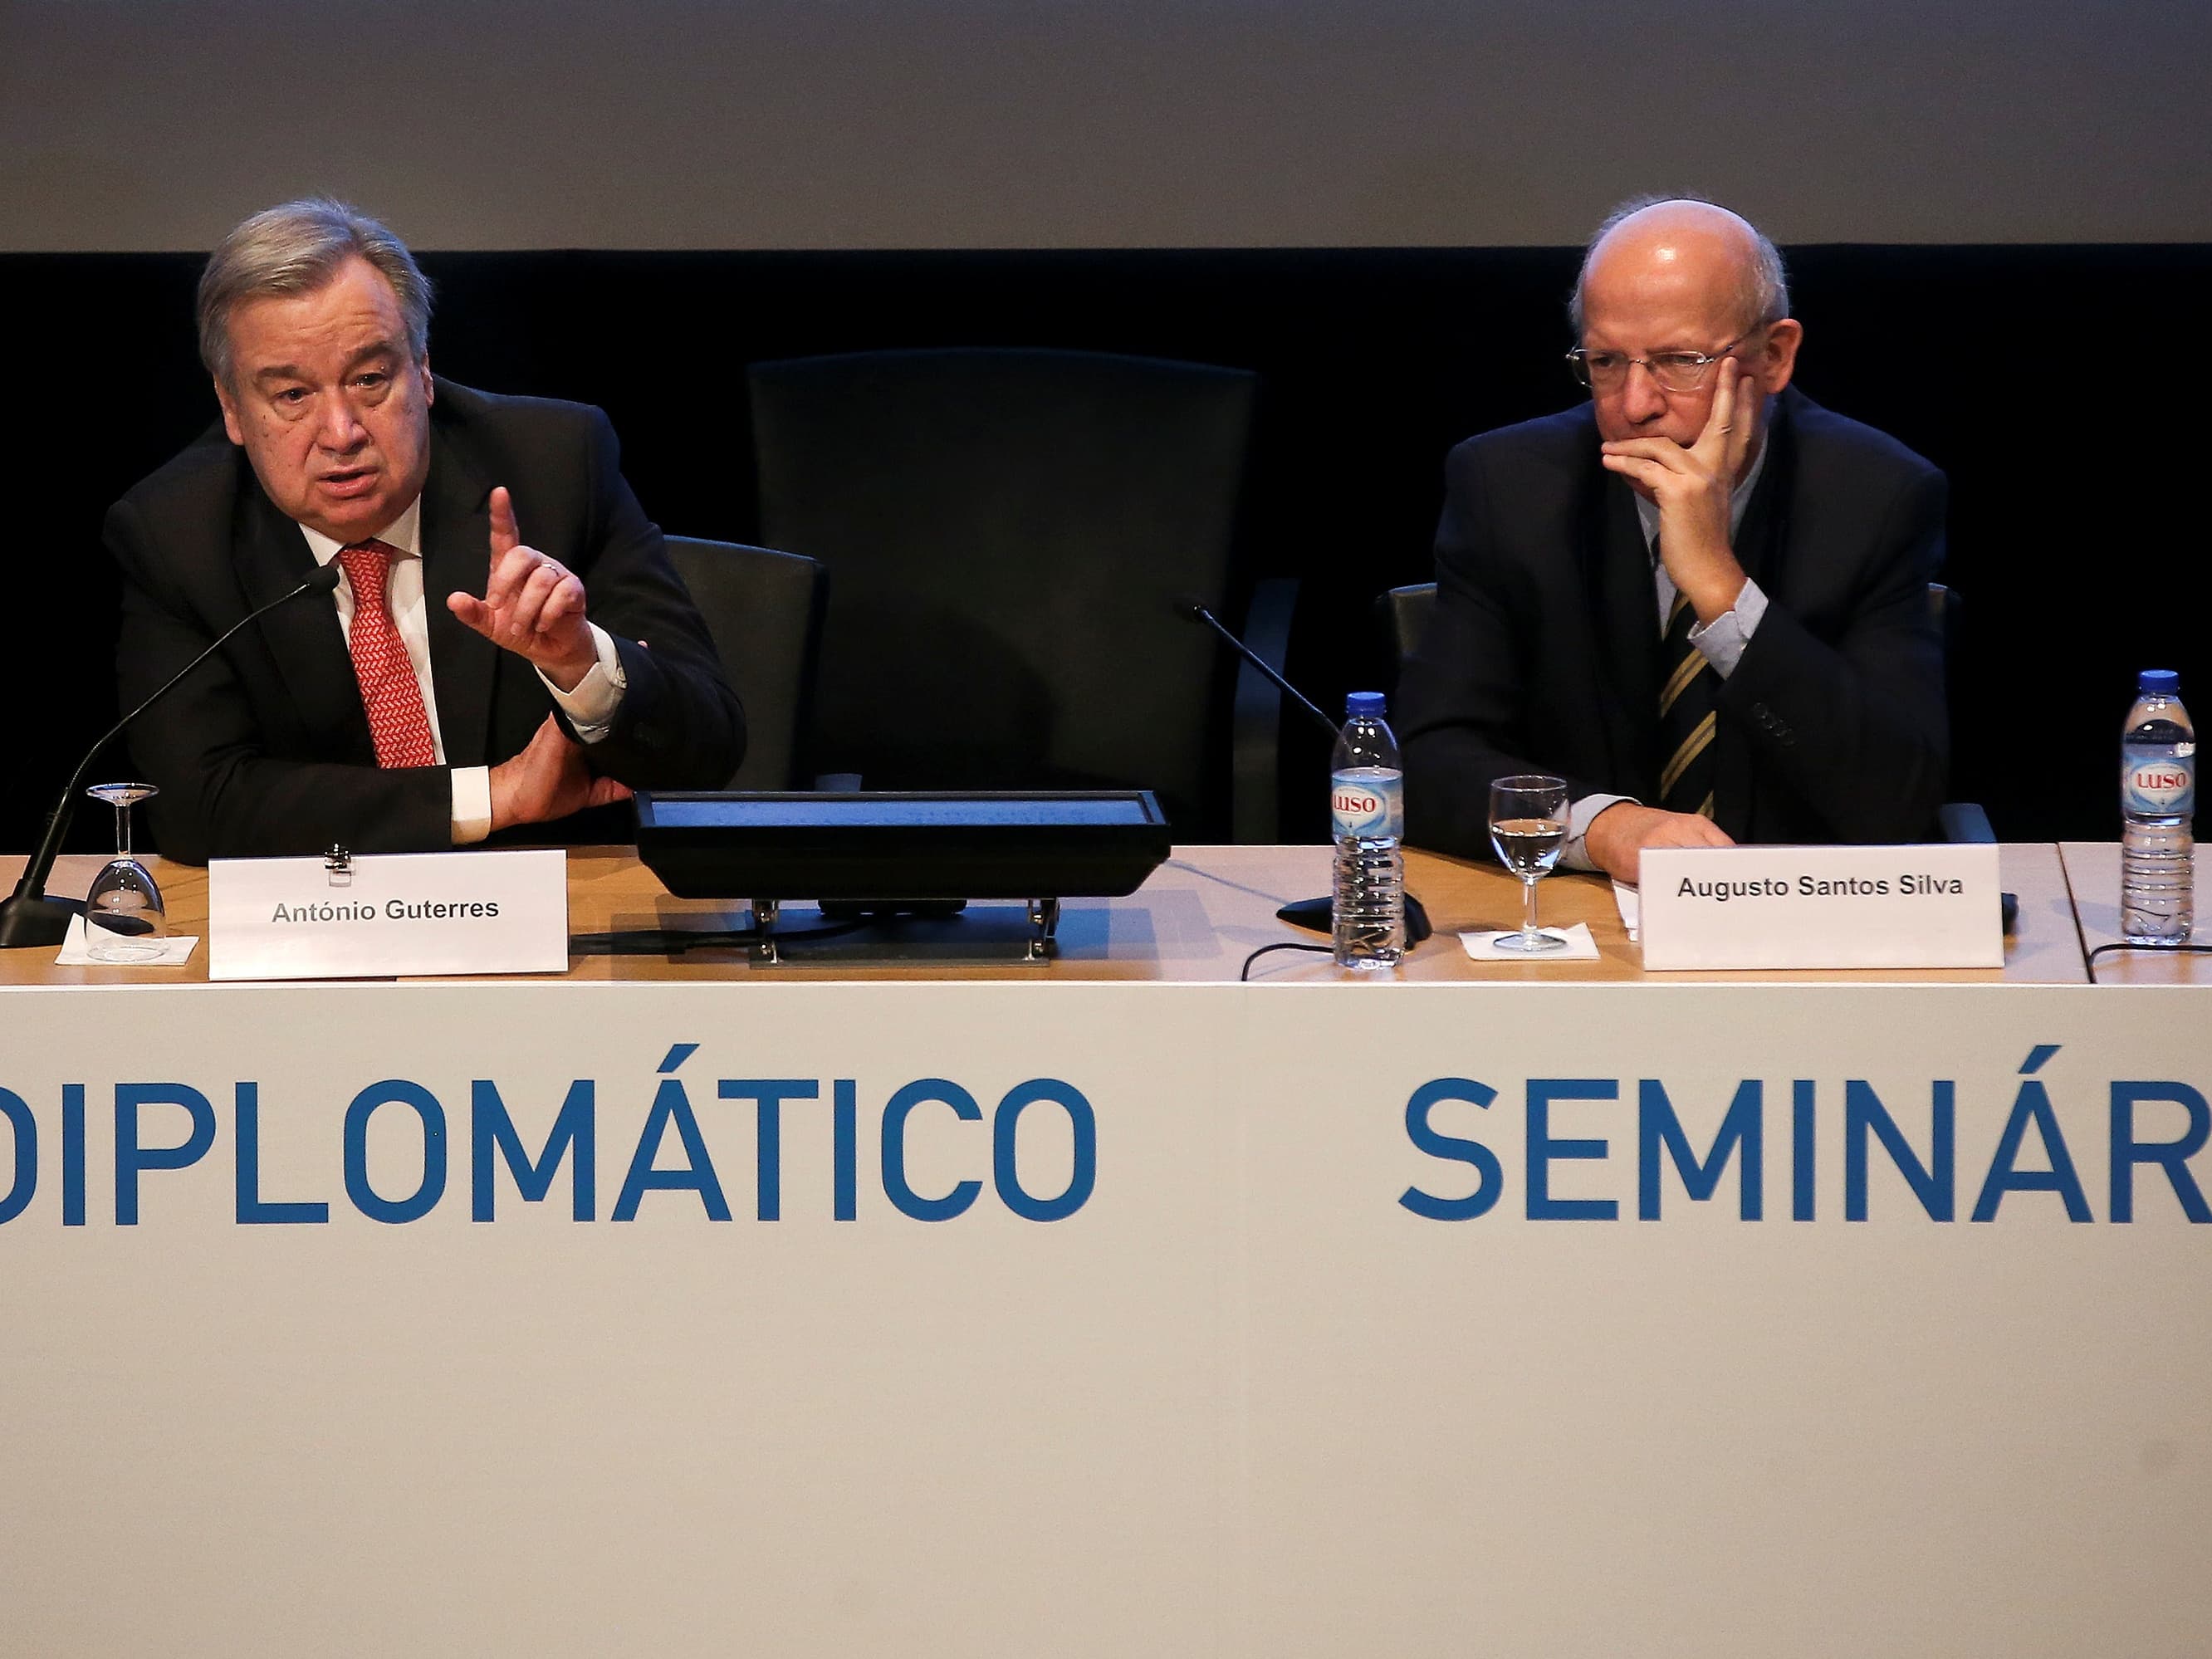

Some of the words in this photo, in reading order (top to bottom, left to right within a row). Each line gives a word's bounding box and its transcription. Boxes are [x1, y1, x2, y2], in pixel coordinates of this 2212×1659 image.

[1677, 877, 1789, 902] Augusto
[1798, 875, 1890, 896] Santos
[1899, 874, 1964, 895] Silva
[272, 901, 376, 922] António
[384, 899, 499, 920] Guterres
[1399, 1045, 2212, 1224] SEMINÁR
